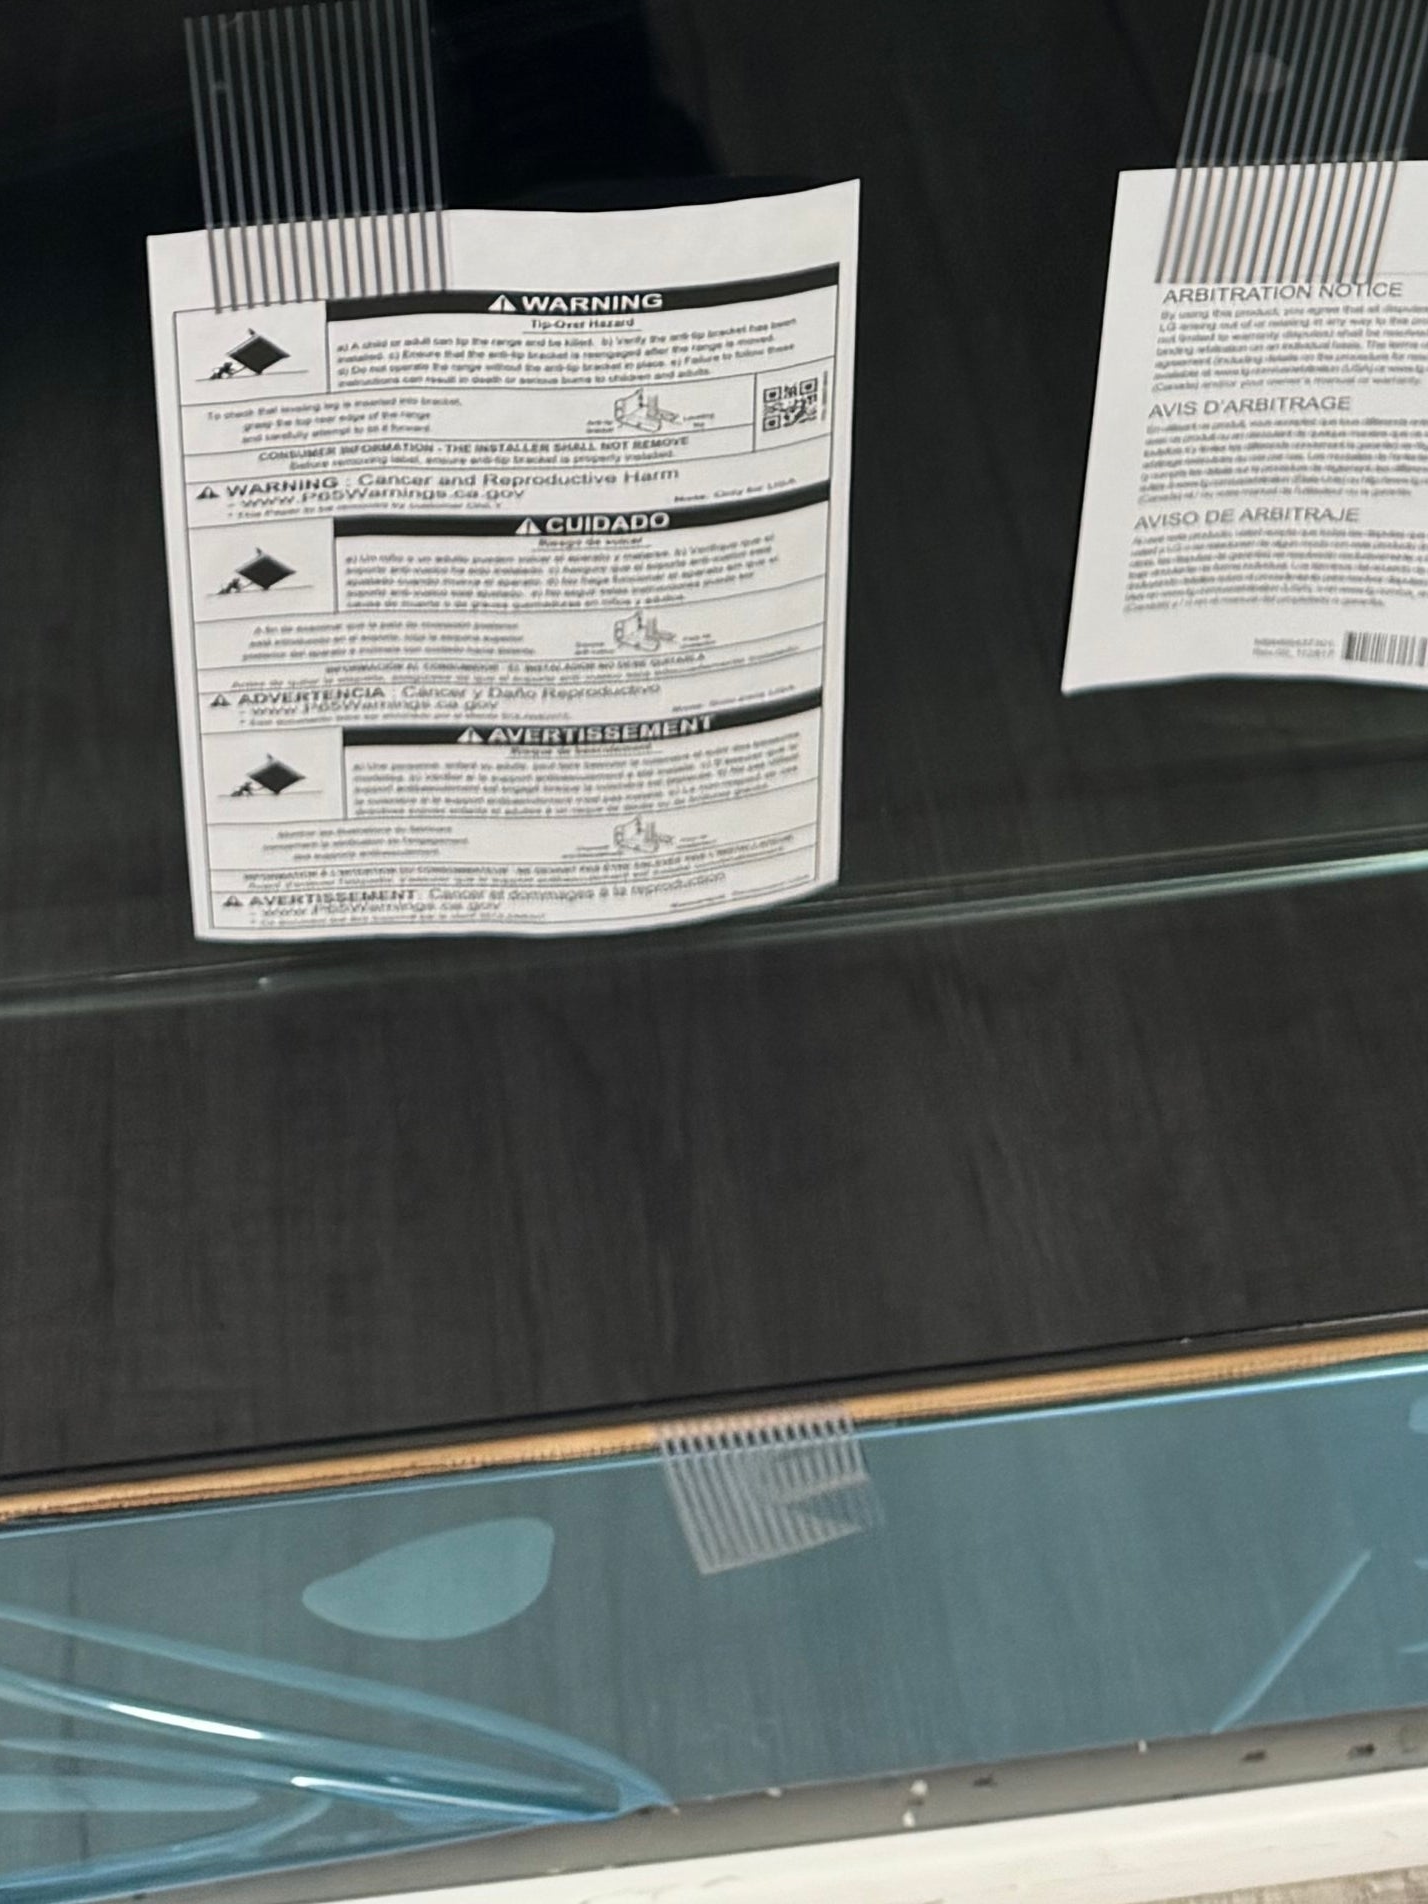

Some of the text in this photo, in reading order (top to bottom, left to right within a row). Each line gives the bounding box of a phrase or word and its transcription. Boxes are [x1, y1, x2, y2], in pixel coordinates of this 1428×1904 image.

[522, 293, 663, 313] WARNING
[1162, 281, 1404, 304] ARBITRATION NOTICE
[589, 318, 636, 329] Hazard
[1148, 396, 1352, 418] AVIS D'ARBITRAGE
[258, 446, 336, 462] CONSUMER
[226, 467, 680, 498] WARNING Cancer and Reproductive Harm
[545, 512, 670, 534] CUIDADO
[1134, 506, 1361, 530] AVISO DE ARBITRAJE
[238, 686, 386, 706] ADVERTENCIA
[487, 715, 712, 743] AVERTISSEMENT
[249, 889, 416, 906] AVERTISSEMENT
